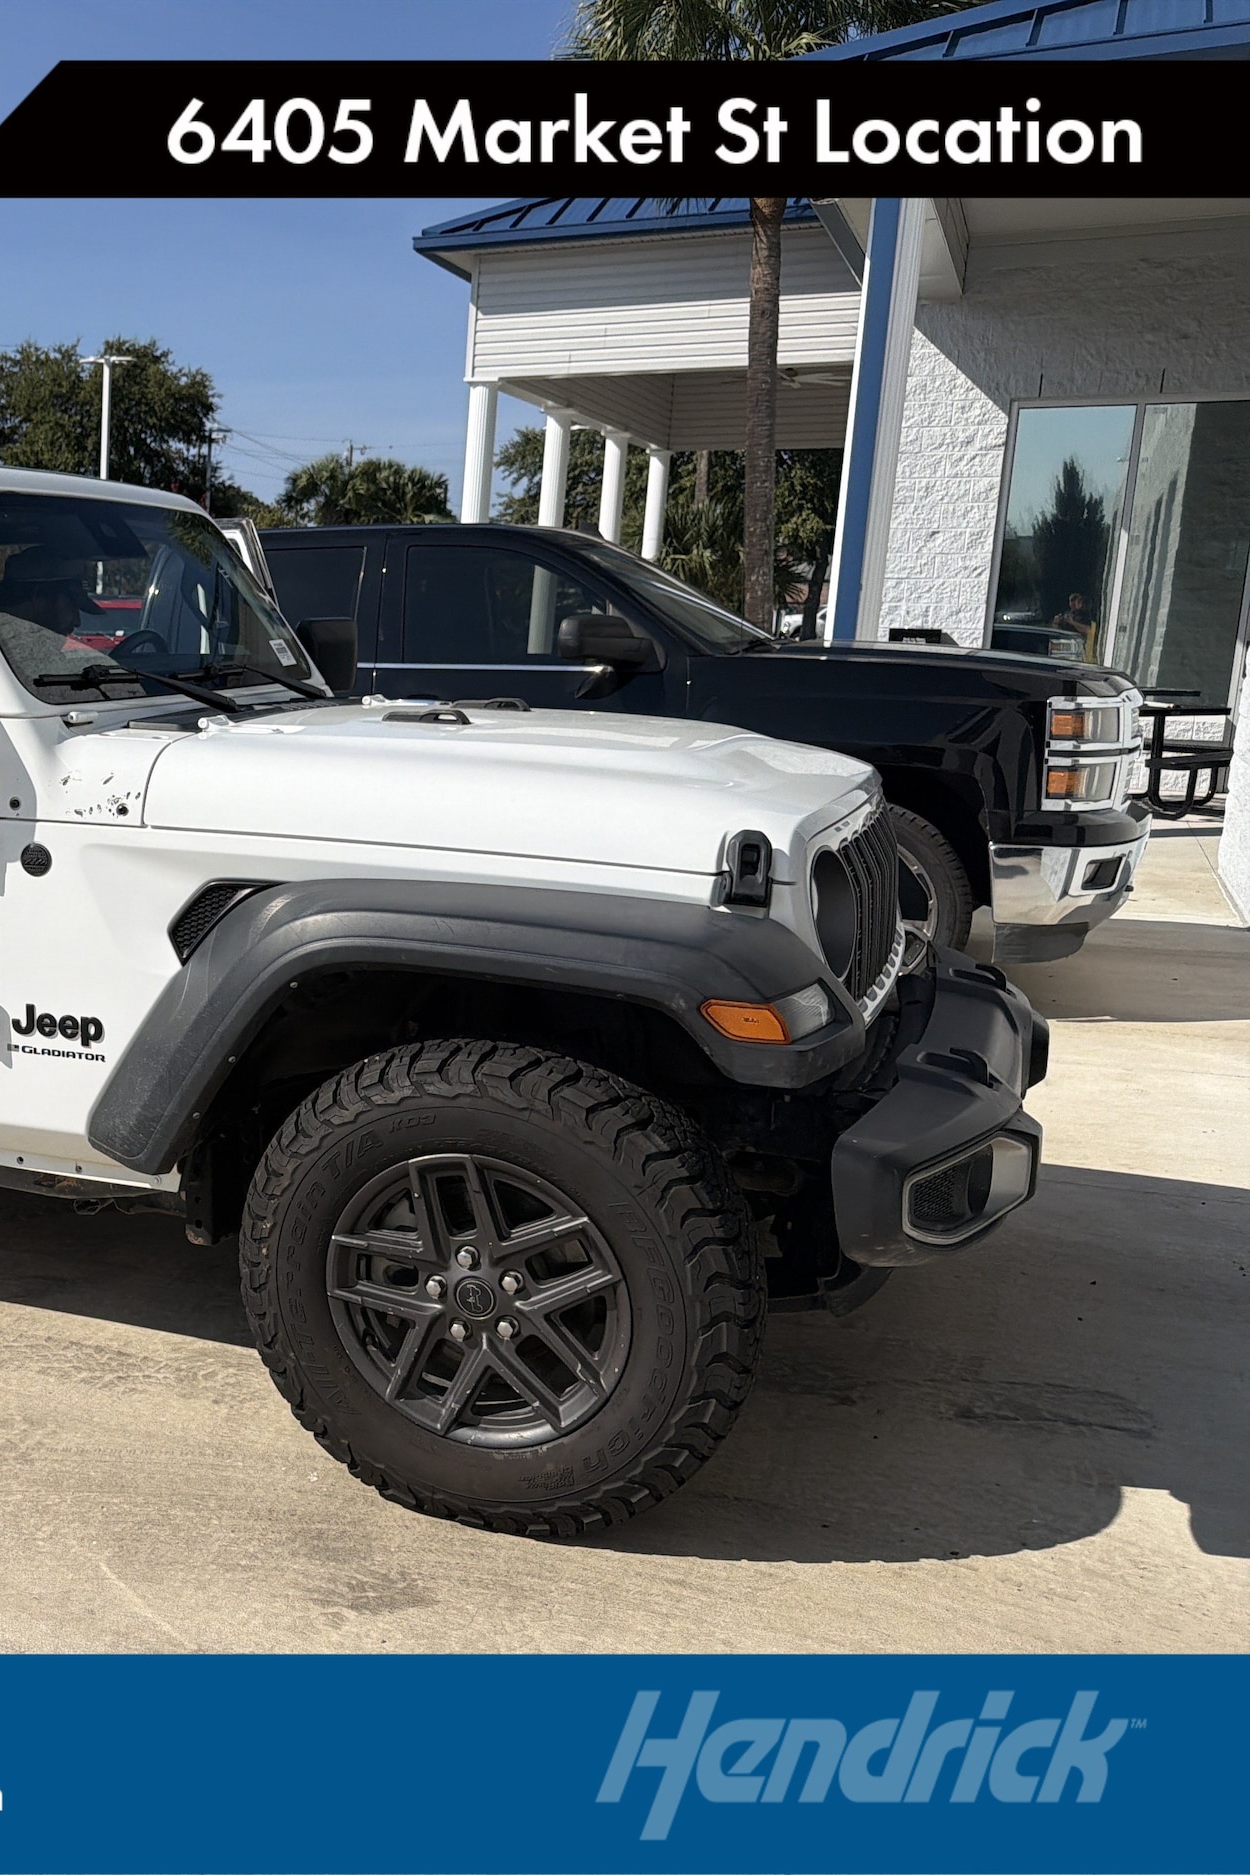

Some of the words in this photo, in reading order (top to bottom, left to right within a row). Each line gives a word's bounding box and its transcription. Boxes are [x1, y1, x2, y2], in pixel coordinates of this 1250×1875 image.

[11, 1003, 104, 1048] Jeep
[21, 1045, 106, 1062] GLADIATOR
[322, 1127, 384, 1180] T/A
